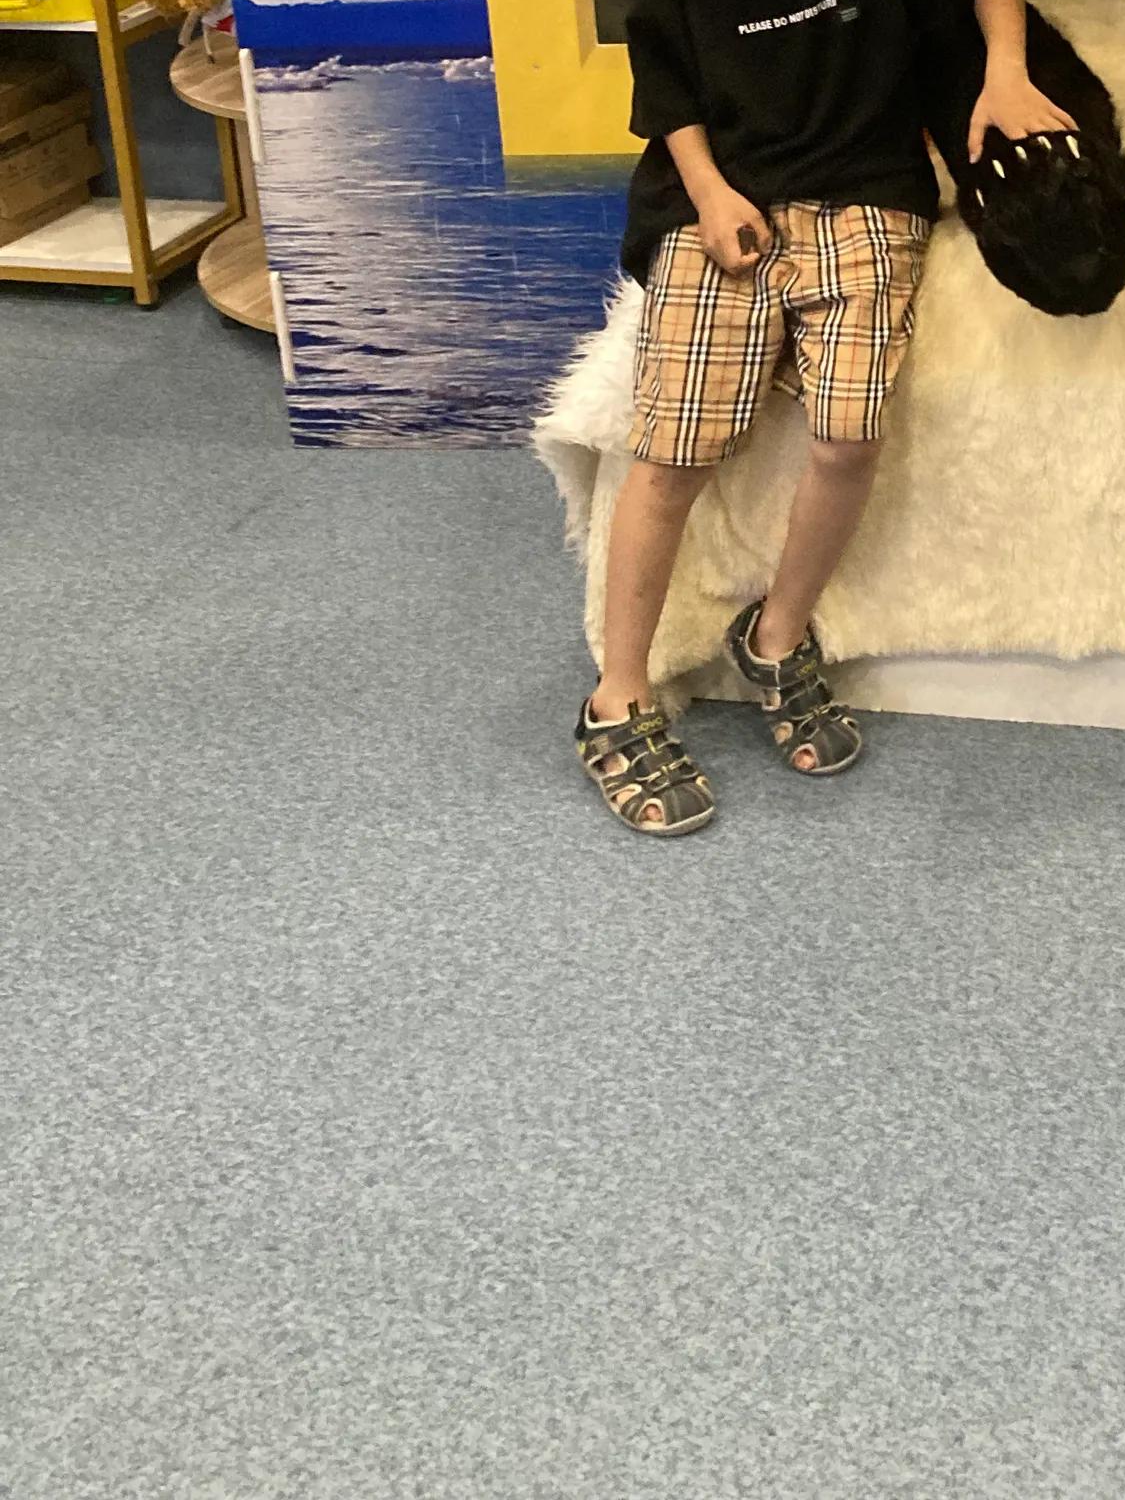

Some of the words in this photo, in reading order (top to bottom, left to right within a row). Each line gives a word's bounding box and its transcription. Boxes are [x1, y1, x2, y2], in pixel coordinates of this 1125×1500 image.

[738, 19, 773, 35] PLEASE
[773, 17, 788, 28] DO
[788, 11, 804, 23] NOT
